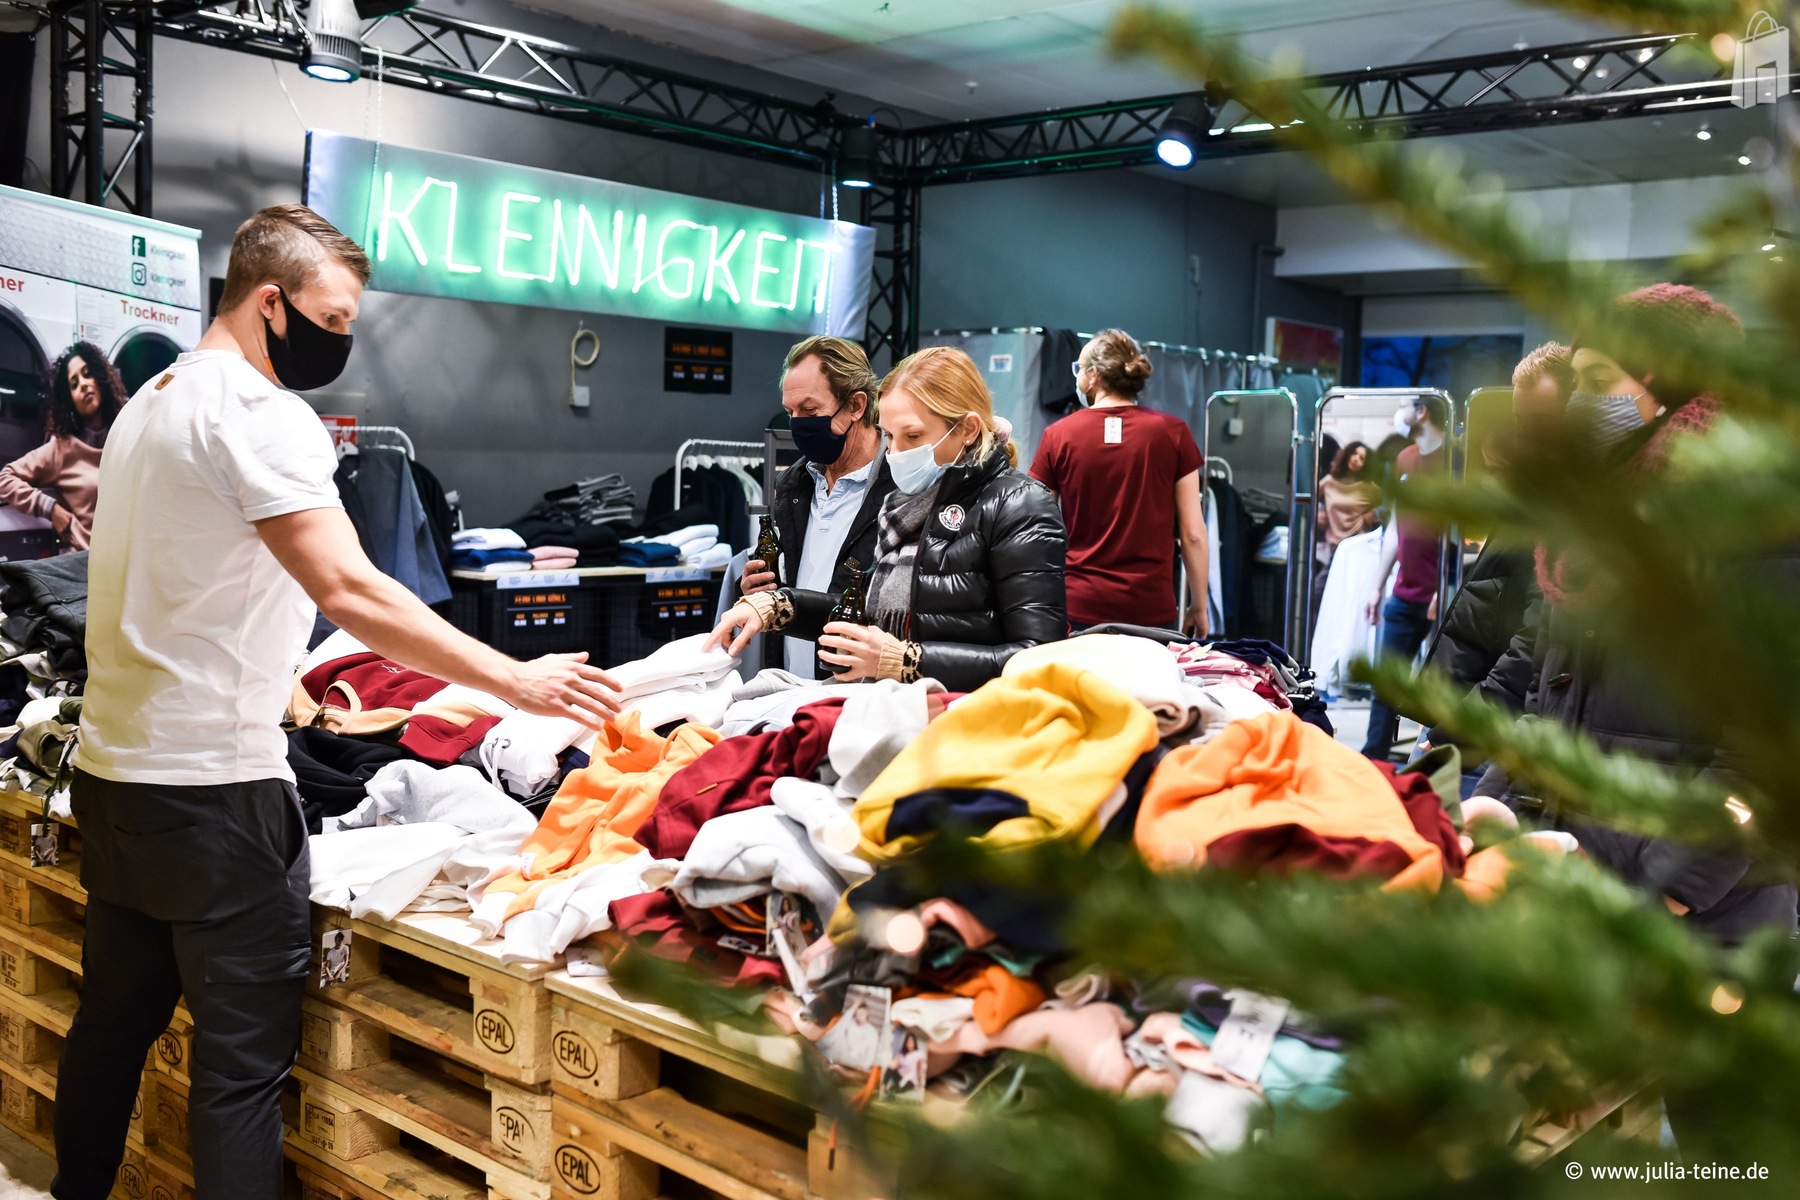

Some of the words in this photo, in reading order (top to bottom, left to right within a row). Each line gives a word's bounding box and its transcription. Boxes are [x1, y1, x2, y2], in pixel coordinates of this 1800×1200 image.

[376, 170, 844, 315] KLEINIGKEIT
[120, 299, 180, 326] Trockner
[160, 1036, 180, 1061] EPAL
[481, 1015, 510, 1049] EPAL
[559, 1036, 591, 1073] EPAL
[124, 1167, 142, 1195] EPAL
[562, 1150, 593, 1188] EPAL
